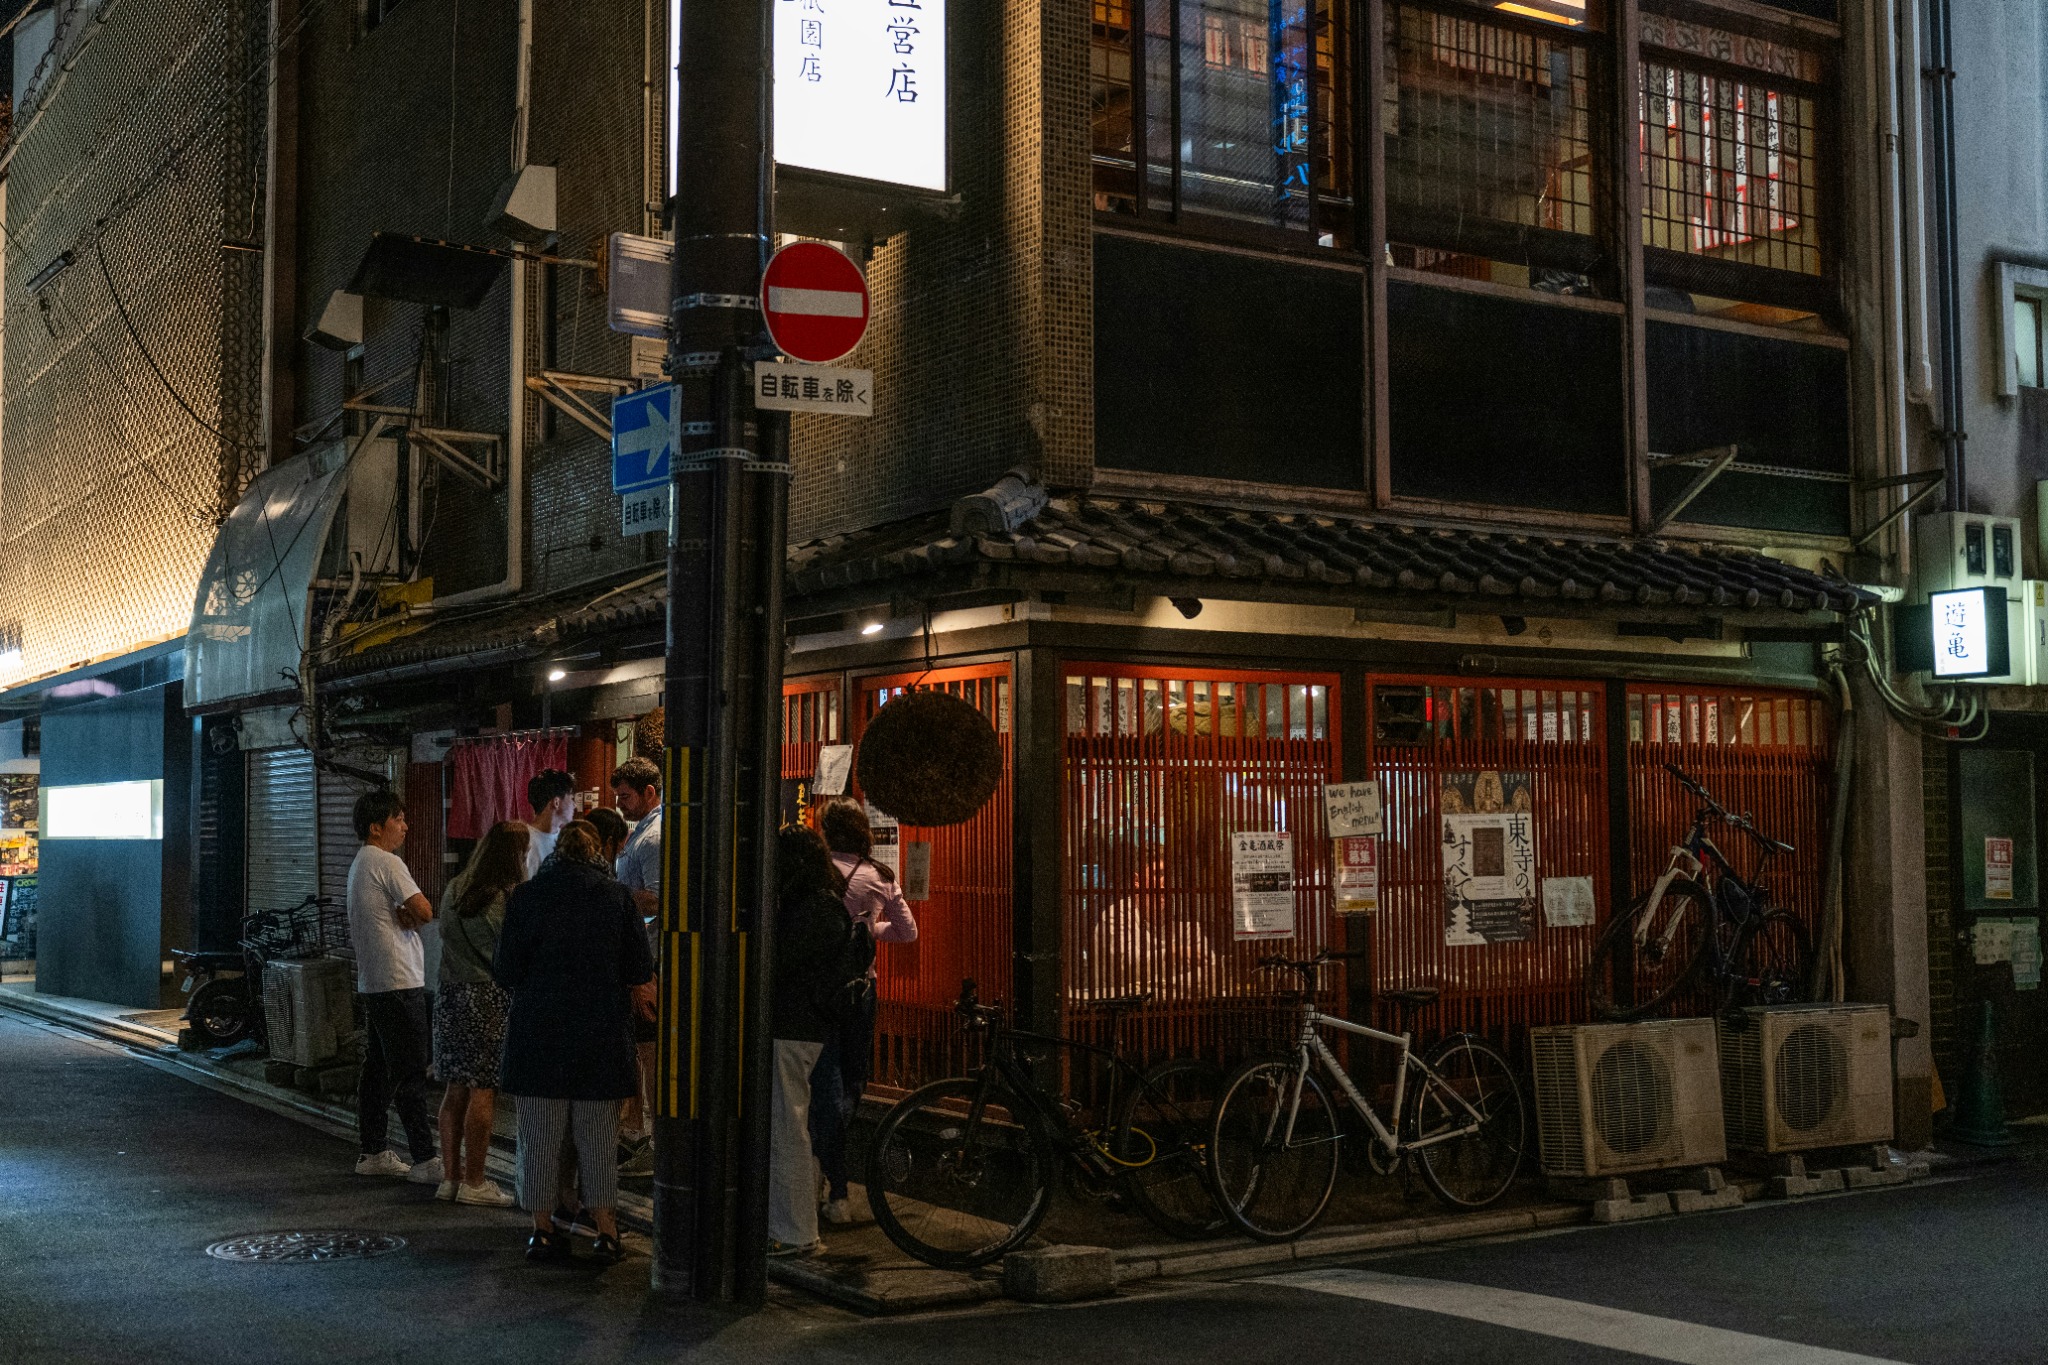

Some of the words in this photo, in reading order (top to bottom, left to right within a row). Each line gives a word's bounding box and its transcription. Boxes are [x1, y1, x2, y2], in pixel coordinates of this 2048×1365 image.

[885, 0, 922, 103] 営店
[761, 372, 868, 404] 自転車を除く
[1329, 801, 1364, 820] English
[1350, 786, 1372, 798] have
[1450, 835, 1472, 901] すべて
[1506, 813, 1533, 890] 東寺の
